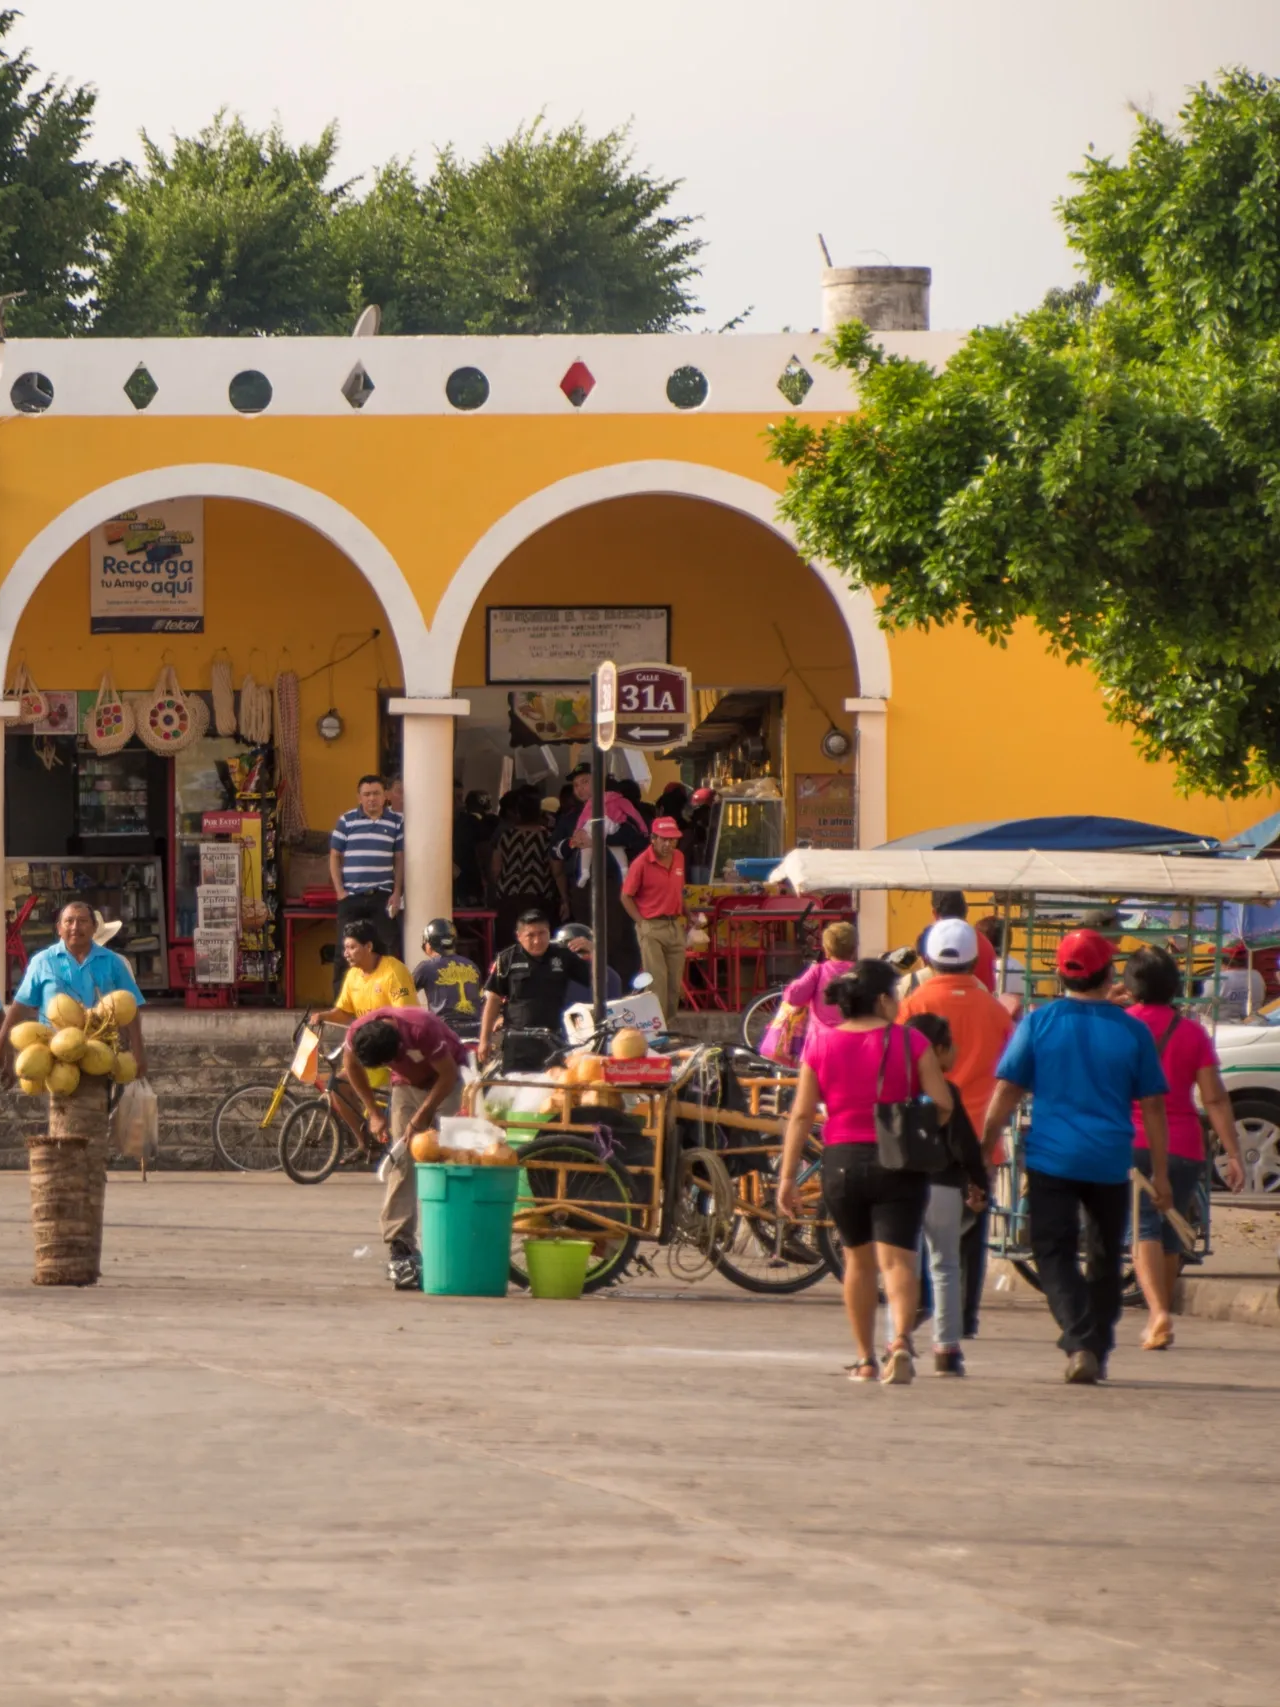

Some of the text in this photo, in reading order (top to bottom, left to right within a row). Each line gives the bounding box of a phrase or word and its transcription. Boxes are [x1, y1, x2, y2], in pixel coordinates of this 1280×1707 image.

[103, 555, 193, 579] Recarga
[101, 579, 149, 591] tu Amigo
[151, 576, 194, 598] aquí
[165, 619, 199, 631] telcel
[636, 673, 660, 682] CALLE
[621, 684, 675, 711] 31A
[203, 818, 218, 827] POR
